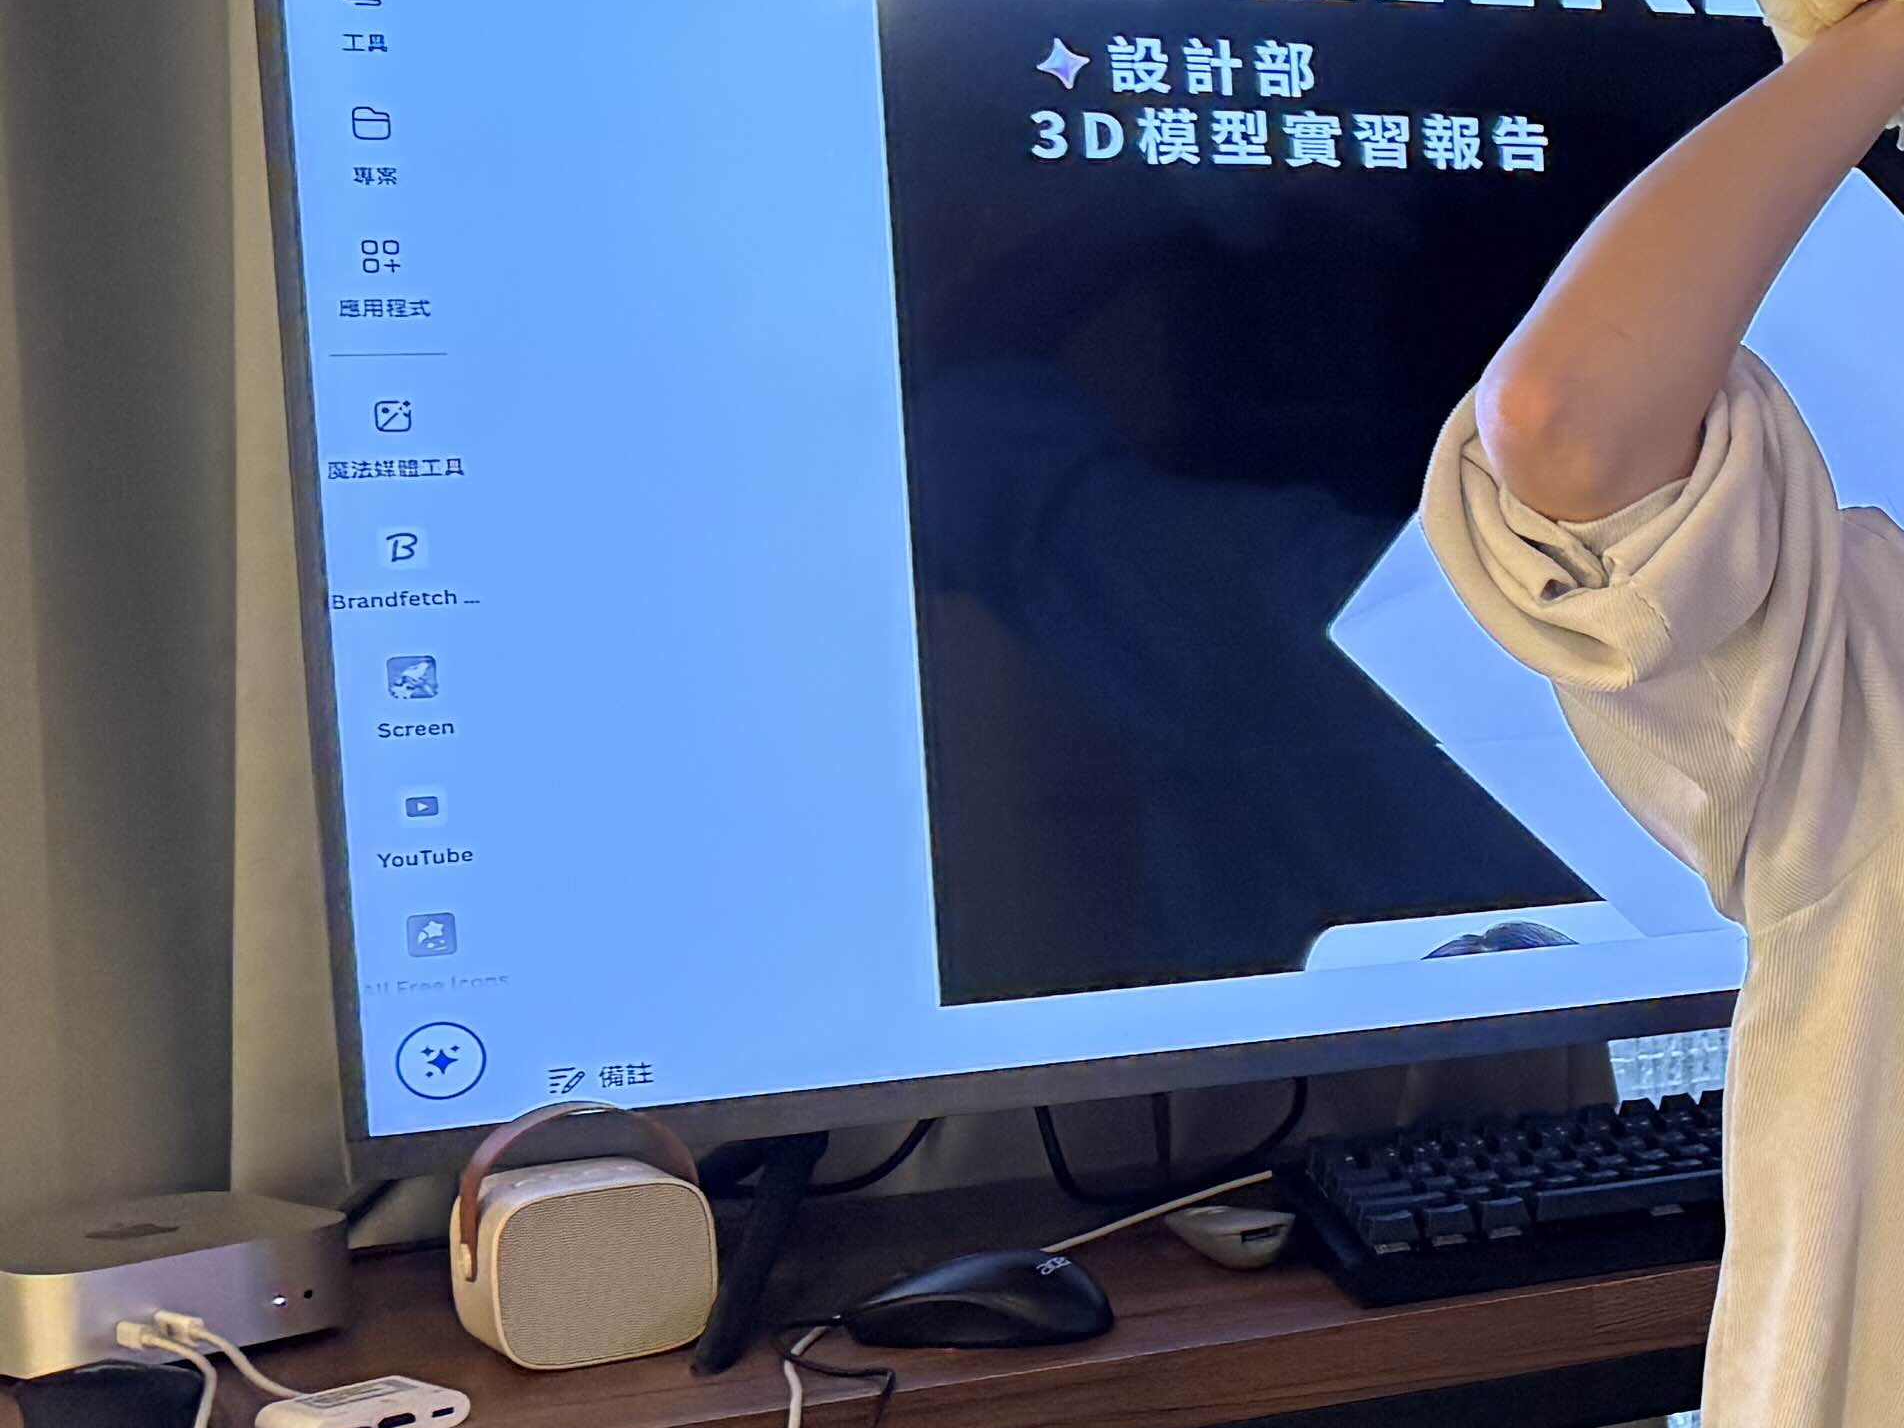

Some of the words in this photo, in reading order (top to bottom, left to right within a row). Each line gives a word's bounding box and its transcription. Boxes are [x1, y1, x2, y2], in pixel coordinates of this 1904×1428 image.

[342, 33, 388, 53] 工具
[1107, 36, 1316, 98] 設計部
[1029, 106, 1549, 173] 3D模型實習報告
[339, 299, 432, 318] 應用程式
[331, 589, 458, 610] Brandfetch
[377, 720, 455, 739] Screen
[376, 848, 474, 869] YouTube
[598, 1062, 655, 1088] 備註
